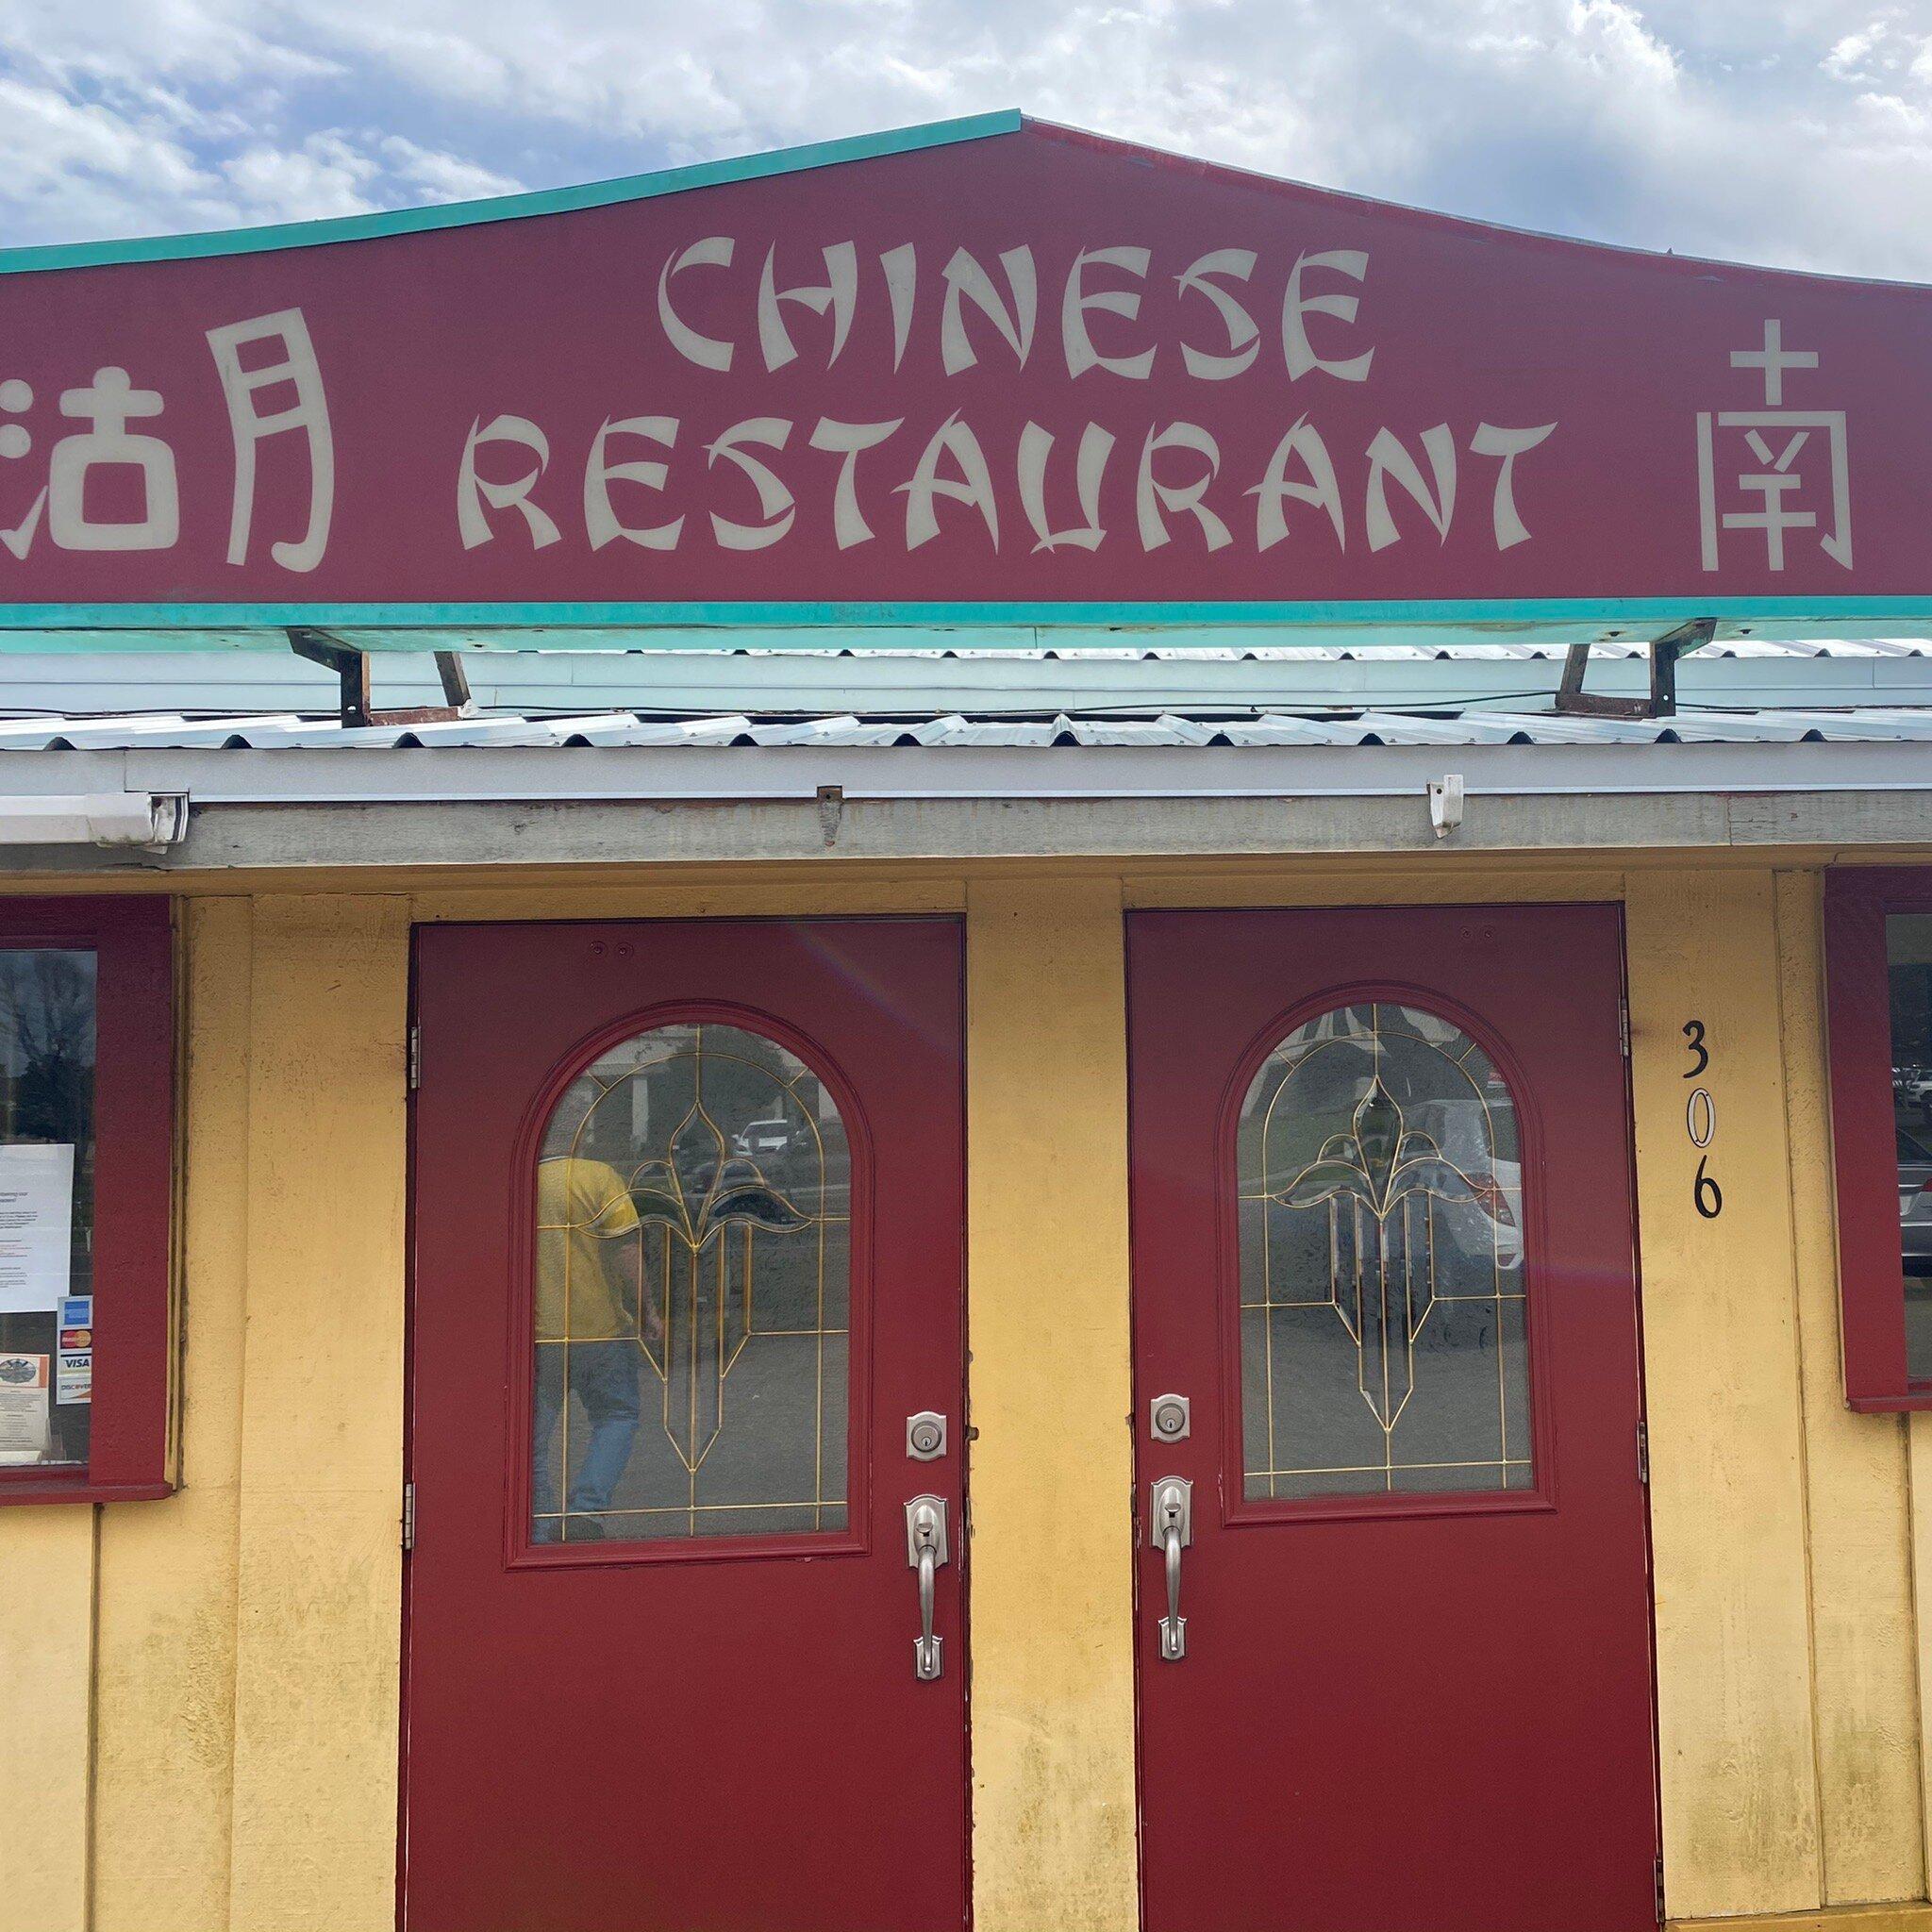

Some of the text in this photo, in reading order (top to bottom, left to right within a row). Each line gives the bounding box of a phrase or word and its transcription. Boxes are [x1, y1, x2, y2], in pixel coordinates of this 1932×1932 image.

[657, 236, 1375, 383] CHINESE
[457, 411, 1558, 554] RESTAURANT
[1695, 318, 1854, 572] 南
[1682, 1020, 1723, 1219] 306
[65, 1358, 90, 1368] VISA
